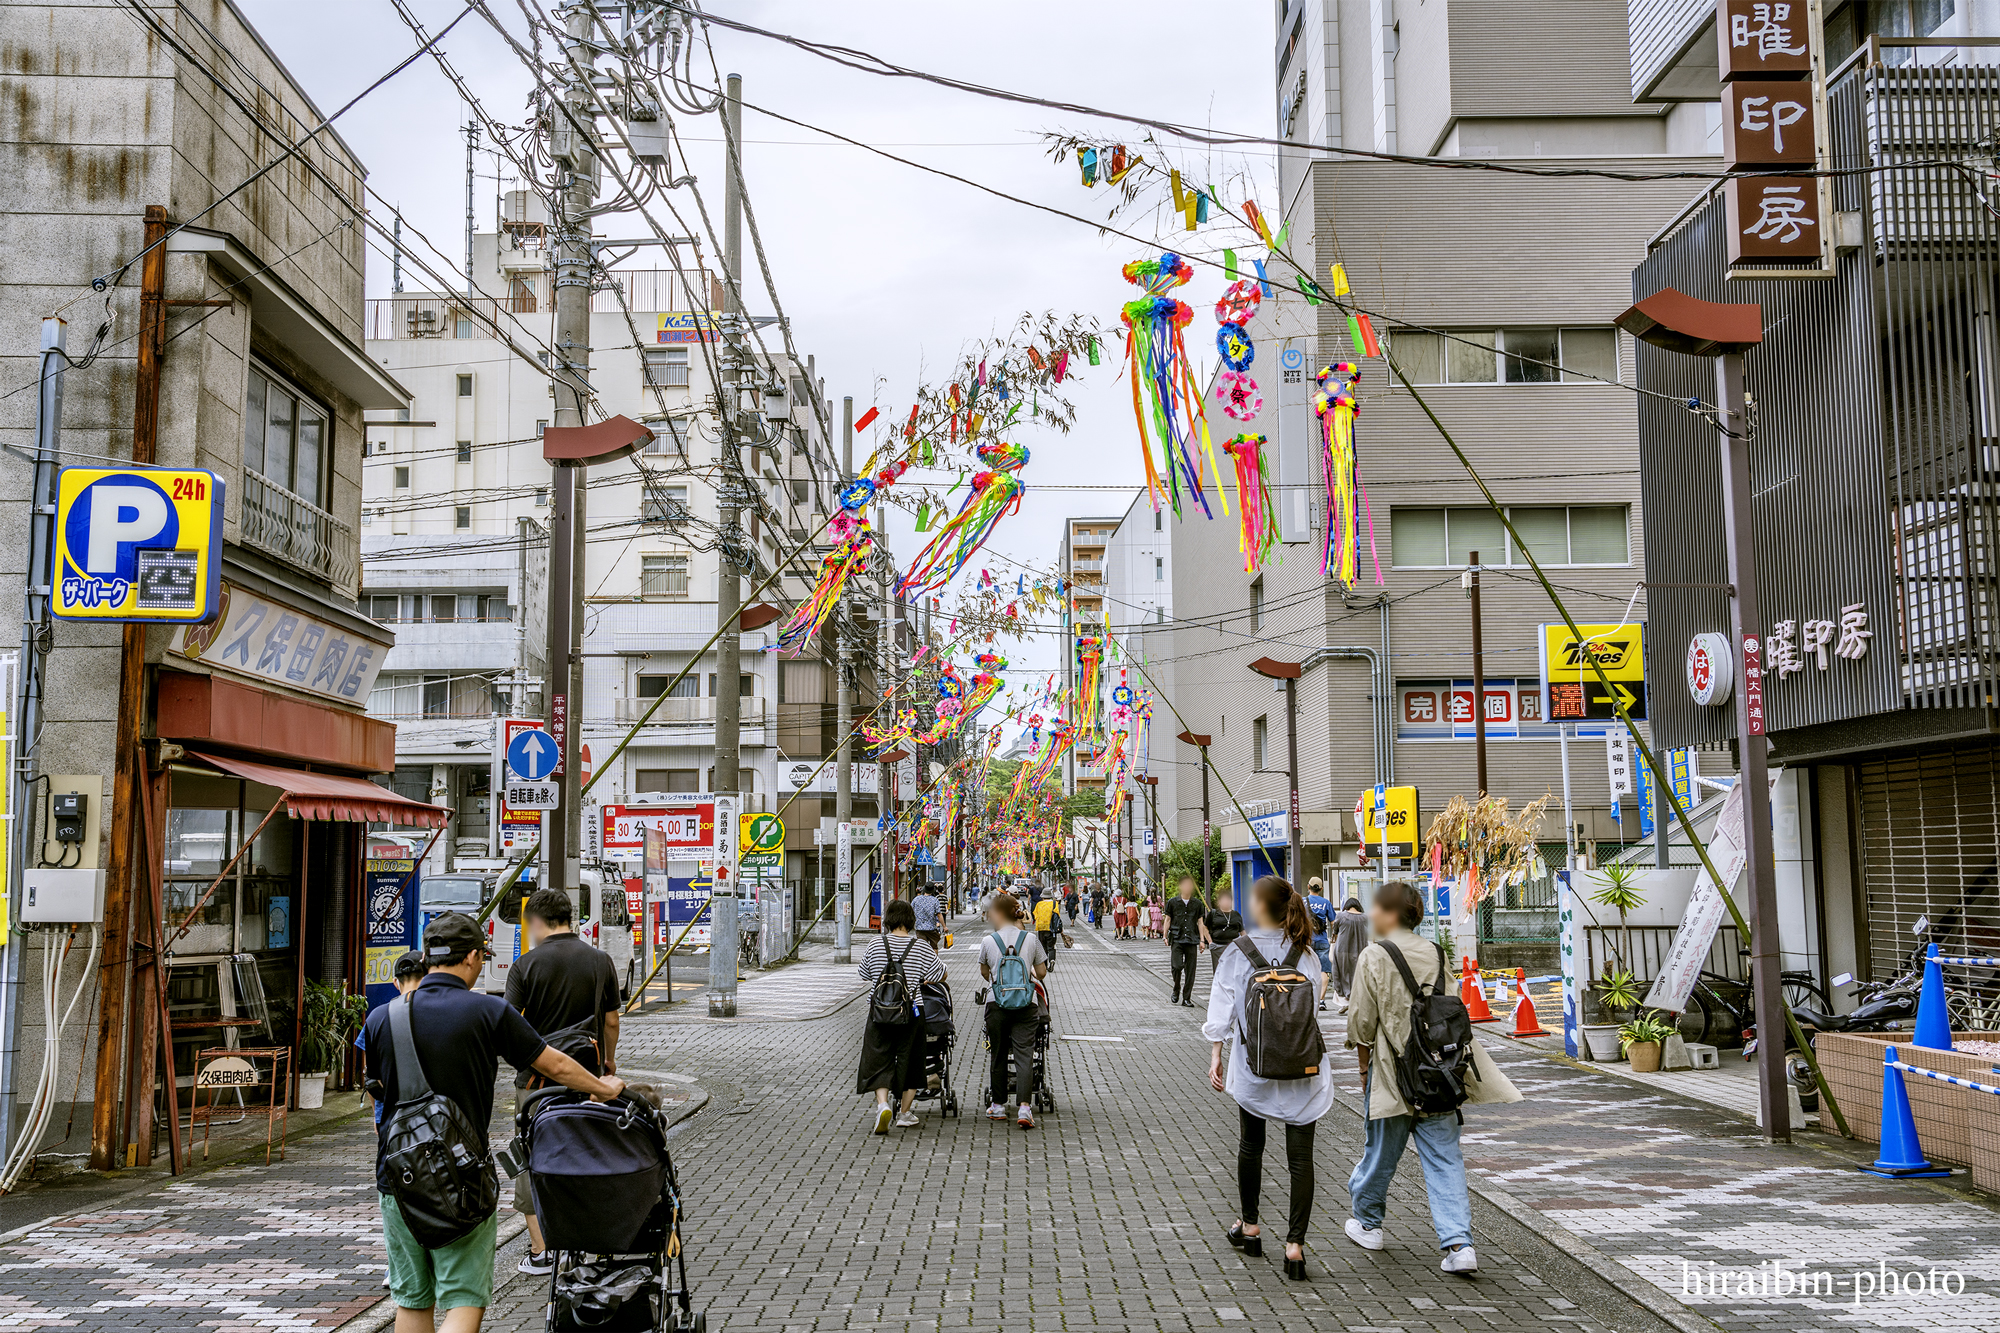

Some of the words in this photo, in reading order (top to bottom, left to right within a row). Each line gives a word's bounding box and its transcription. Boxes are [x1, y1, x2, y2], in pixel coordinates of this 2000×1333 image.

[1231, 298, 1244, 309] 七
[1231, 389, 1244, 403] 祭
[173, 478, 205, 500] 24h
[87, 485, 167, 573] P
[138, 552, 197, 608] 空
[62, 578, 129, 609] ザ・パーク
[222, 600, 373, 697] 久保田肉店
[1590, 643, 1608, 652] 24h
[1766, 602, 1873, 680] 曜印房
[1695, 653, 1708, 685] はん
[1551, 684, 1586, 717] 満
[1746, 656, 1762, 732] 八幡大門通り
[1612, 740, 1626, 790] 東曜印房
[510, 788, 555, 804] 自転車を除く
[618, 823, 629, 837] 30
[686, 819, 696, 836] 円
[741, 815, 753, 824] 24h
[760, 821, 778, 845] P
[370, 860, 398, 872] ¥100
[368, 921, 405, 935] BOSS
[201, 1069, 253, 1084] 久保田肉店
